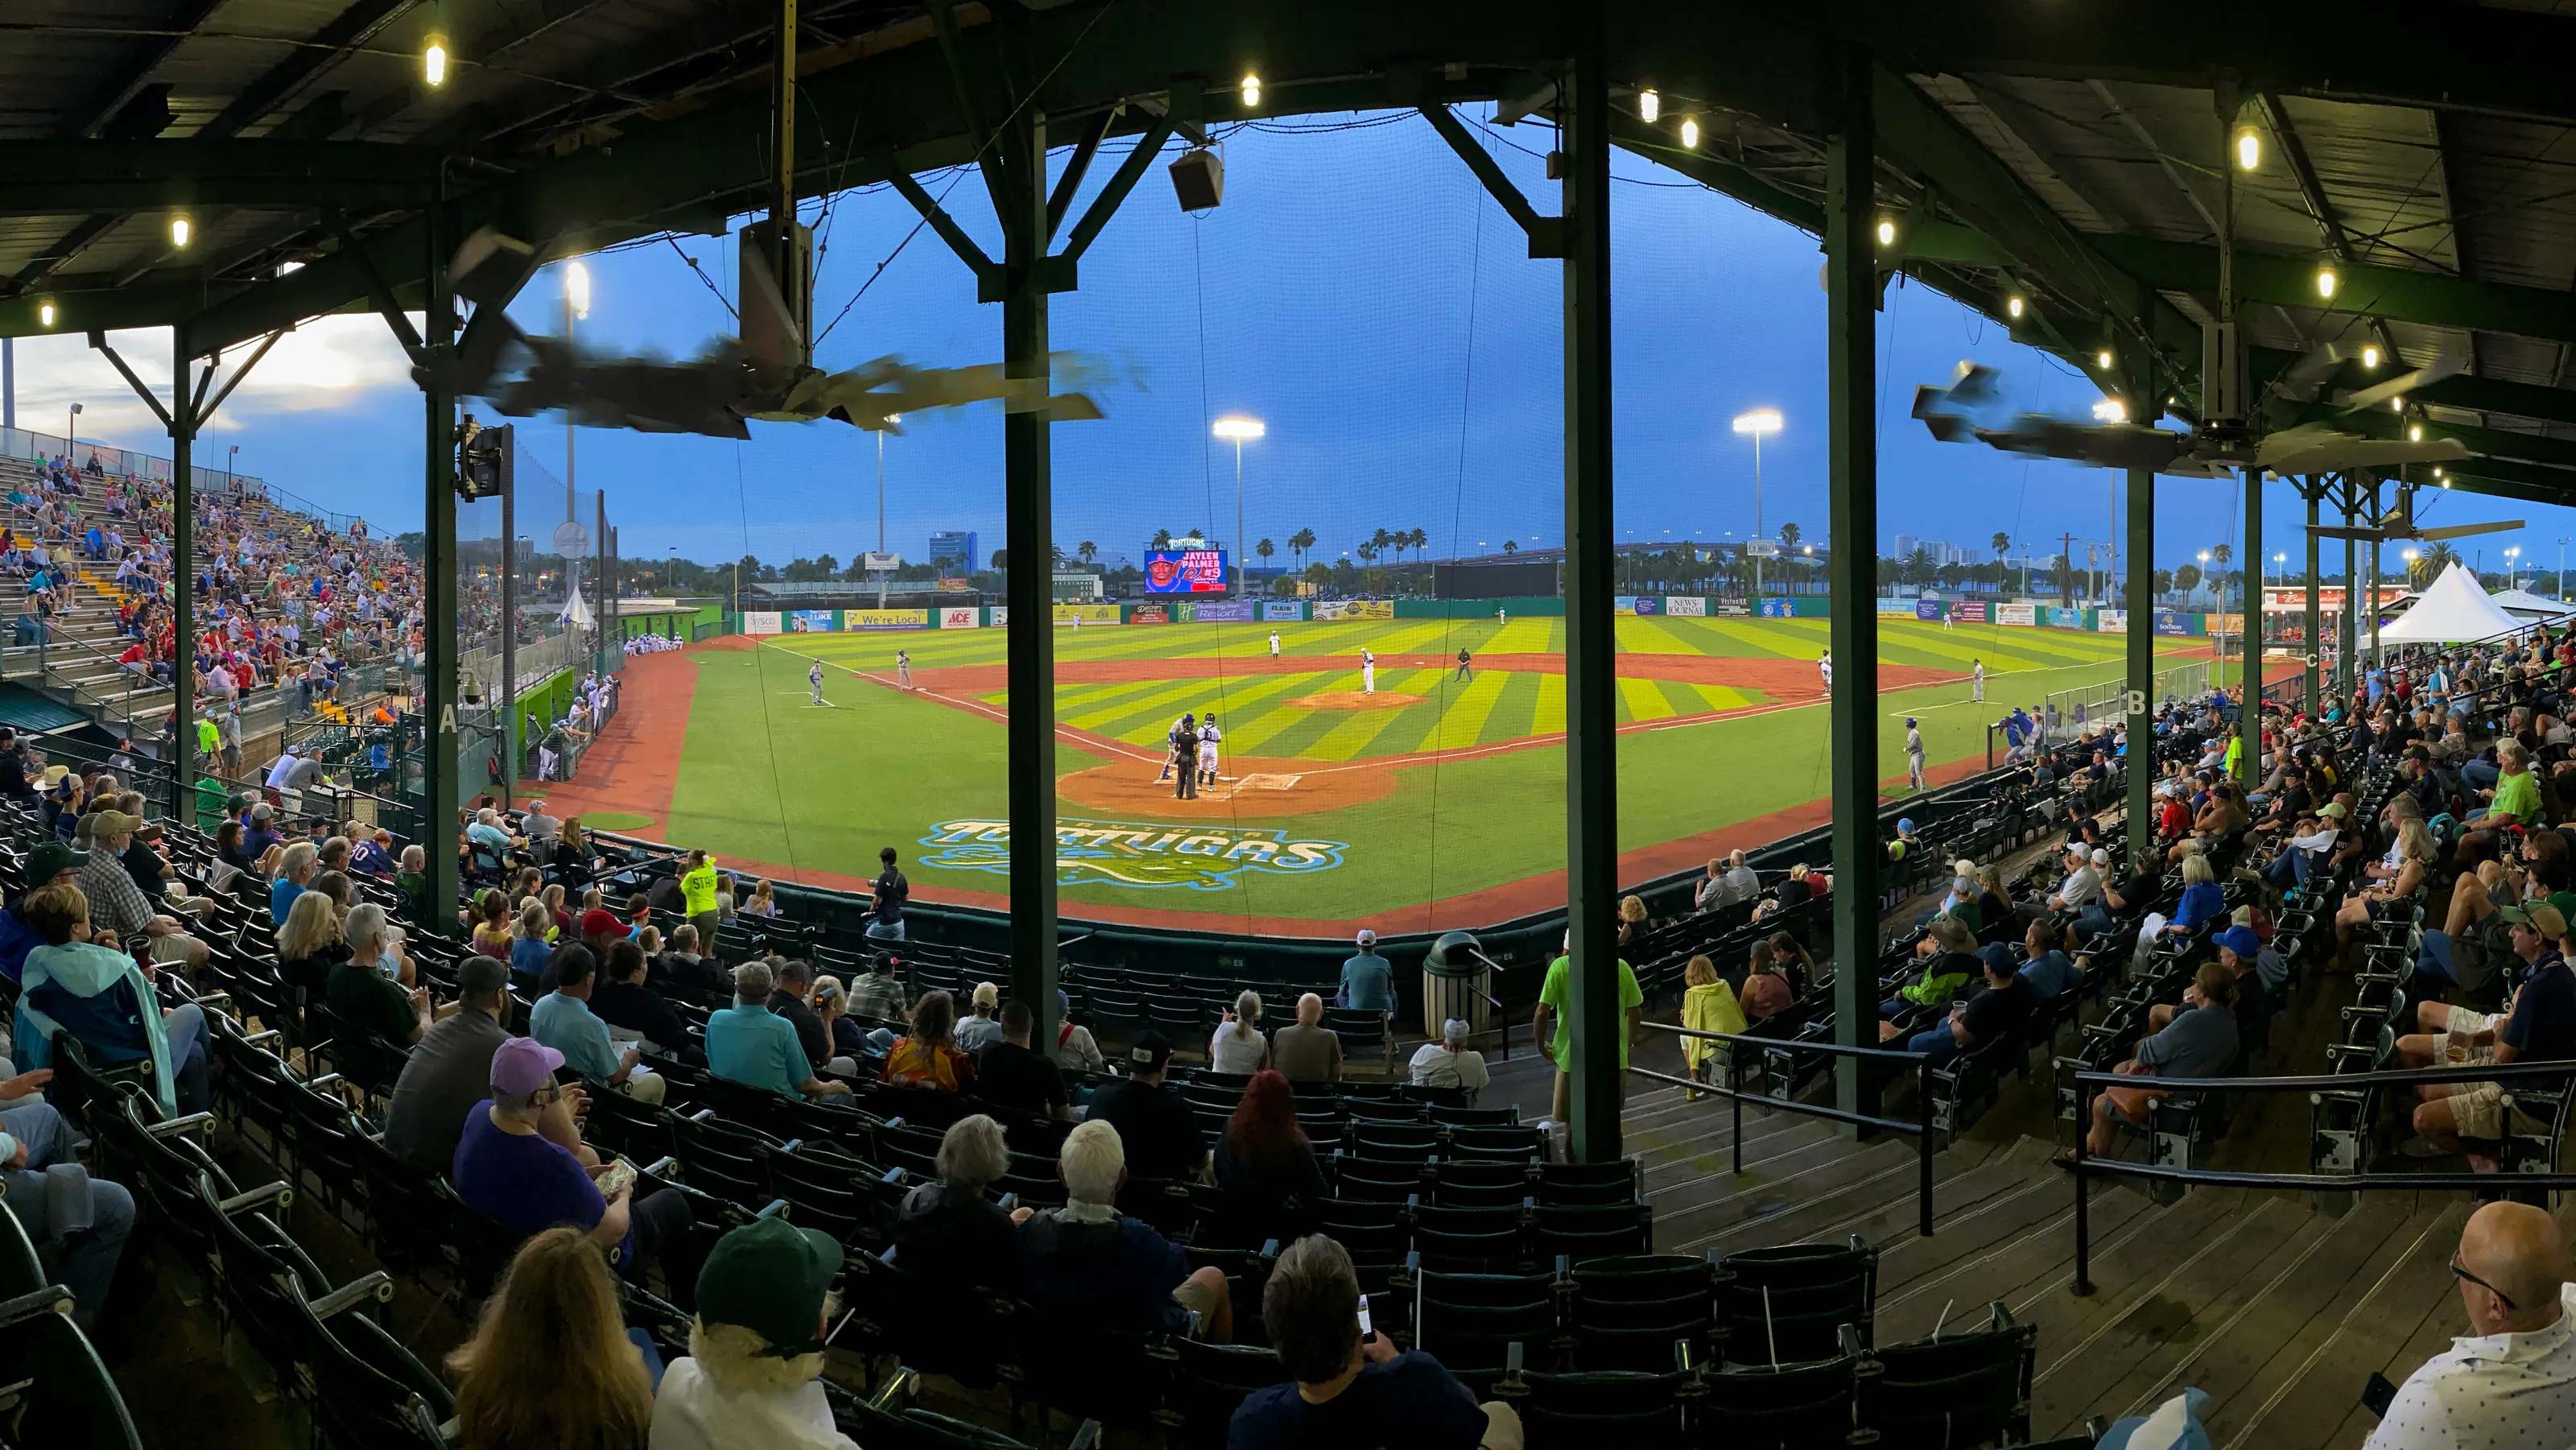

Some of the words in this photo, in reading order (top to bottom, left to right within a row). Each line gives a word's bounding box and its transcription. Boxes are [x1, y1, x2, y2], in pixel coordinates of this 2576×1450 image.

[1169, 538, 1205, 548] TORTUGAS
[1183, 551, 1219, 560] JAYLEN
[1182, 560, 1220, 568] PALMER
[1204, 568, 1221, 579] #9
[1199, 609, 1236, 618] Resort
[1669, 606, 1704, 615] JOURNAL
[750, 614, 775, 626] Sysco
[862, 615, 893, 624] We're
[896, 615, 921, 624] Local
[948, 613, 970, 623] ACE
[2306, 653, 2318, 667] C
[2128, 689, 2145, 715] B
[439, 704, 458, 733] A
[1056, 820, 1262, 837] AYTONA
[693, 874, 716, 890] STAF
[1233, 959, 1244, 967] E5
